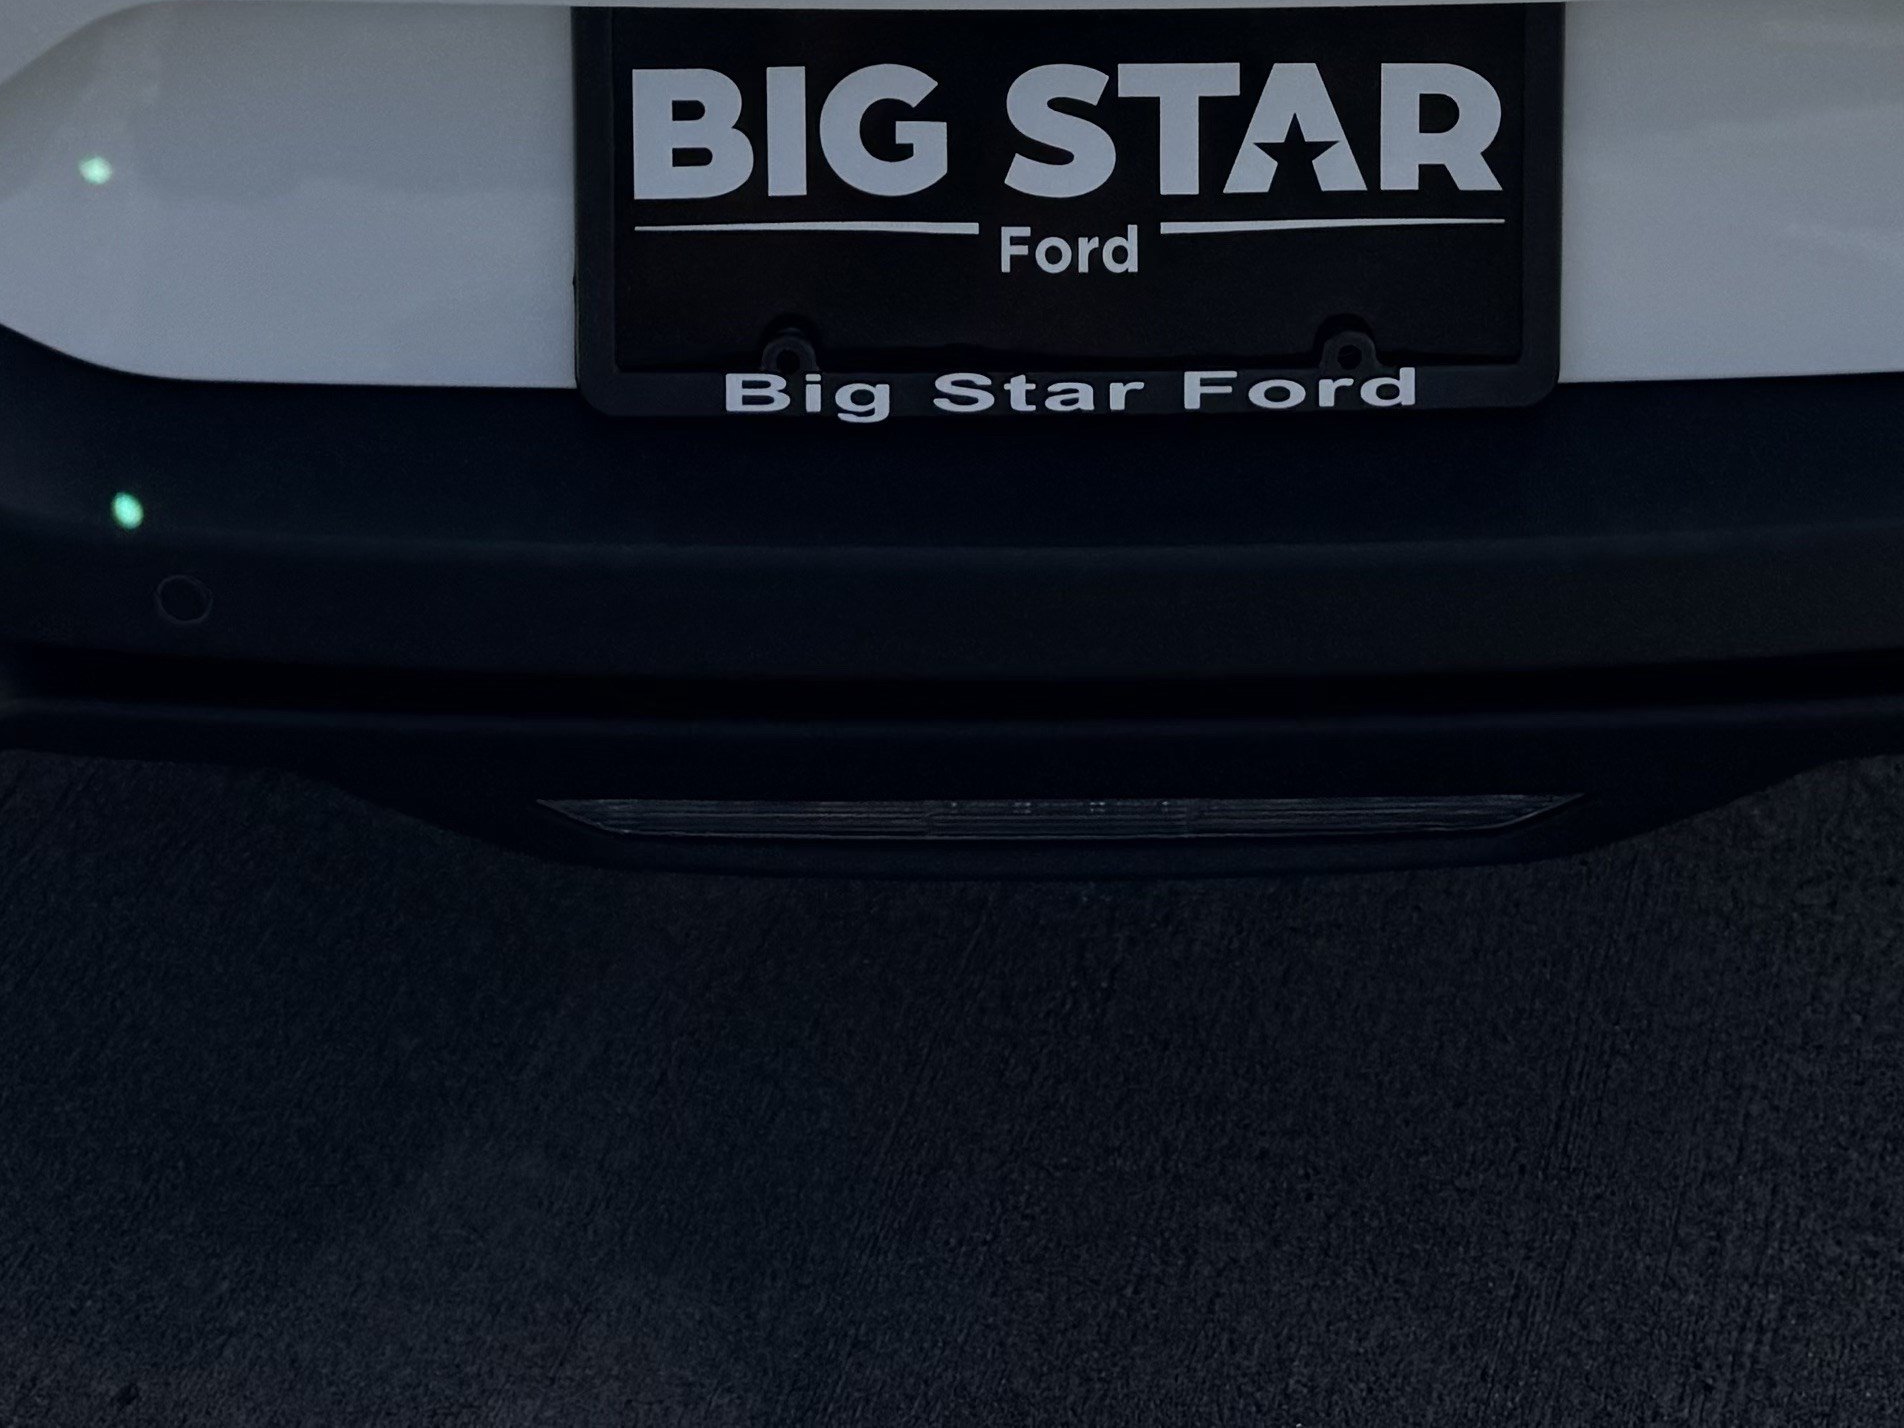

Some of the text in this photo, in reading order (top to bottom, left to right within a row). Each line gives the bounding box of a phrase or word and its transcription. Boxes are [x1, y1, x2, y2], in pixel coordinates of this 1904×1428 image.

[631, 61, 1503, 200] BIG STAR
[1000, 225, 1139, 274] Ford
[725, 366, 1417, 423] Big Star Ford
